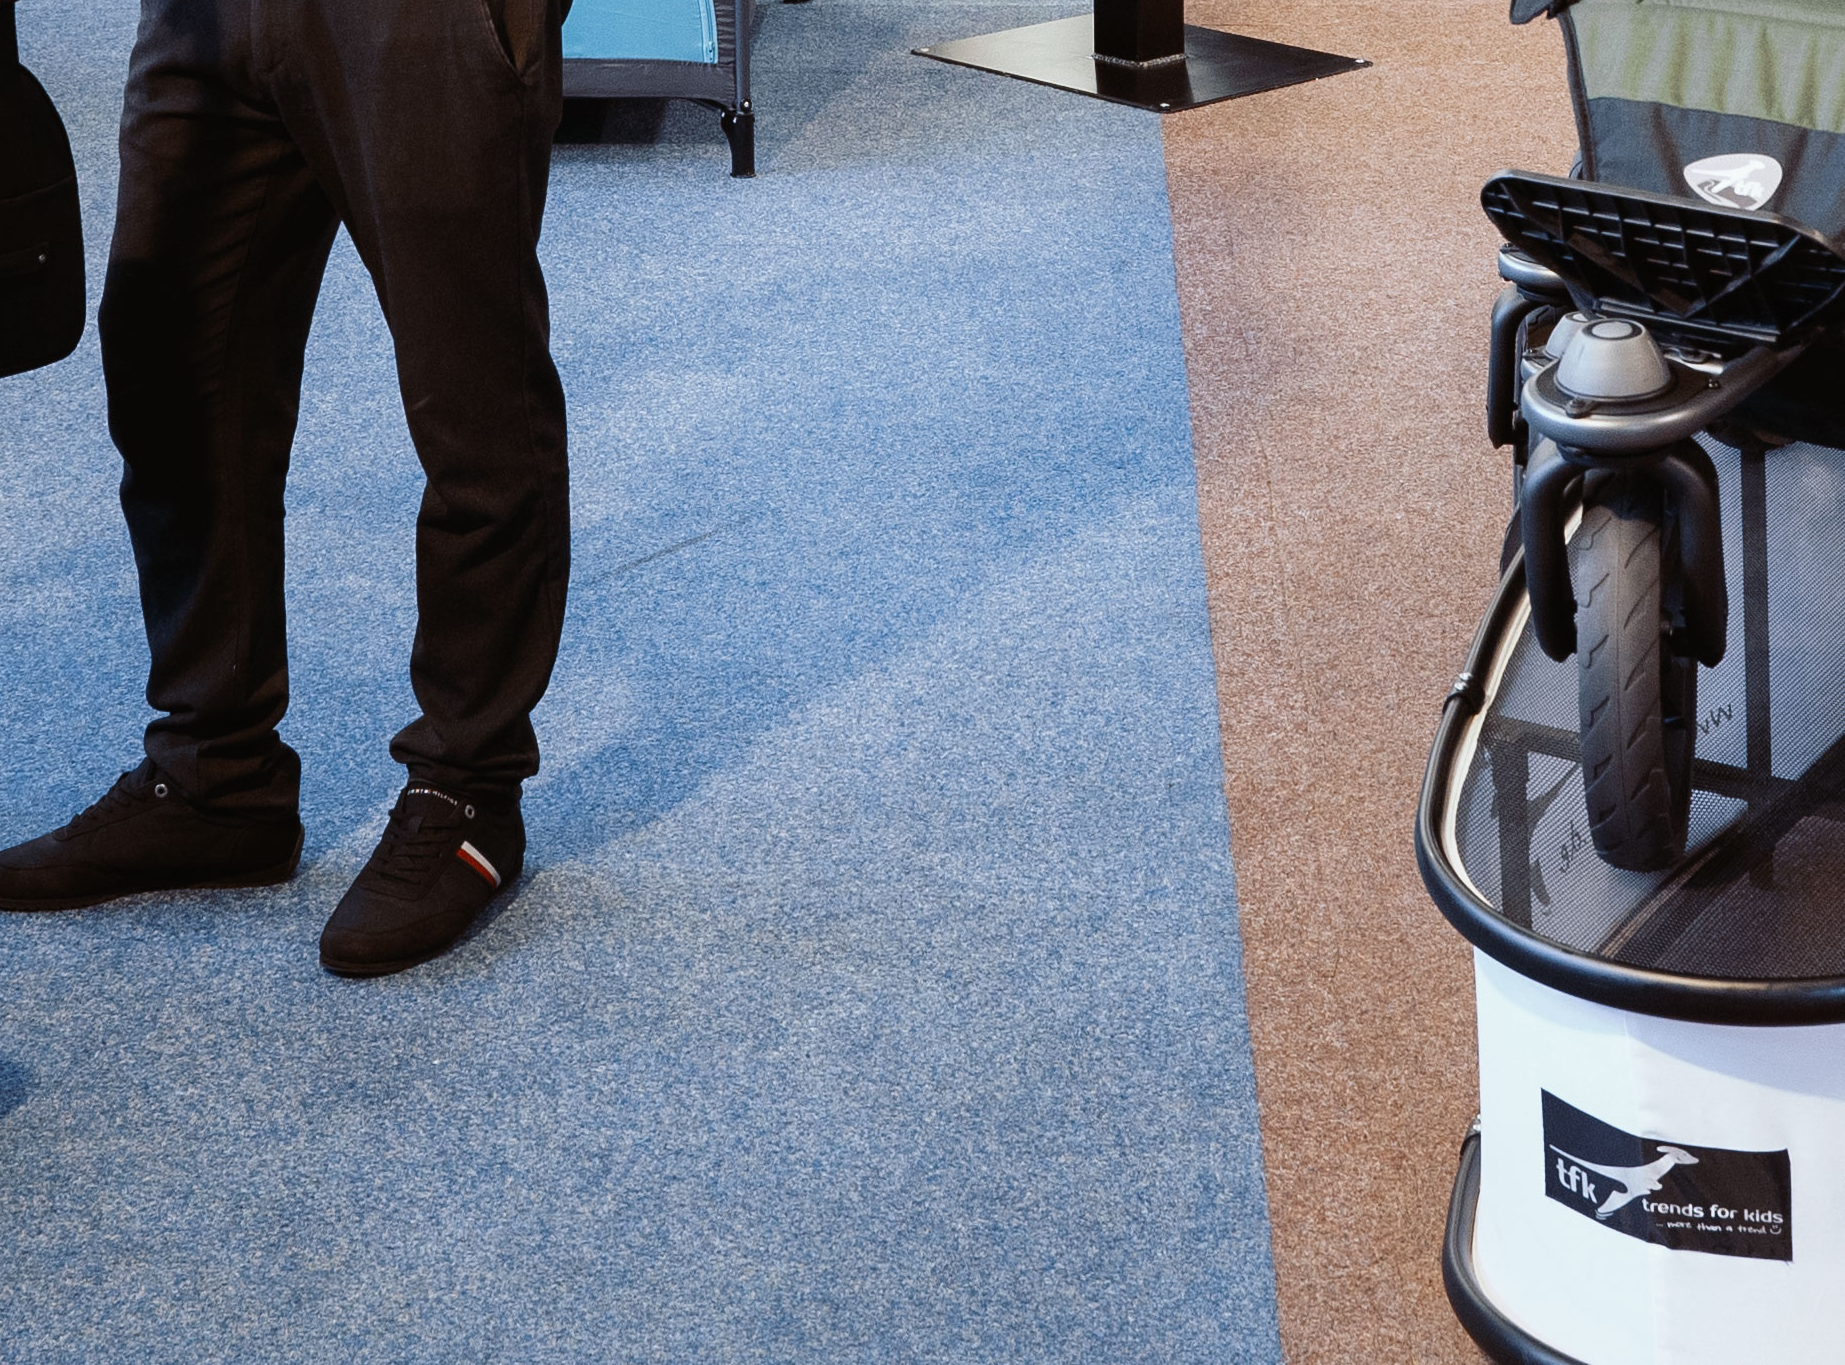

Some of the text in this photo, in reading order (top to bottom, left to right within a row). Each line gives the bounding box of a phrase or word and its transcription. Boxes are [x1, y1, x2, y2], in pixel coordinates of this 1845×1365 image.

[1556, 1157, 1598, 1204] tfk
[1641, 1198, 1784, 1224] trends for kids
[1666, 1221, 1692, 1229] more
[1737, 1224, 1767, 1234] trend
